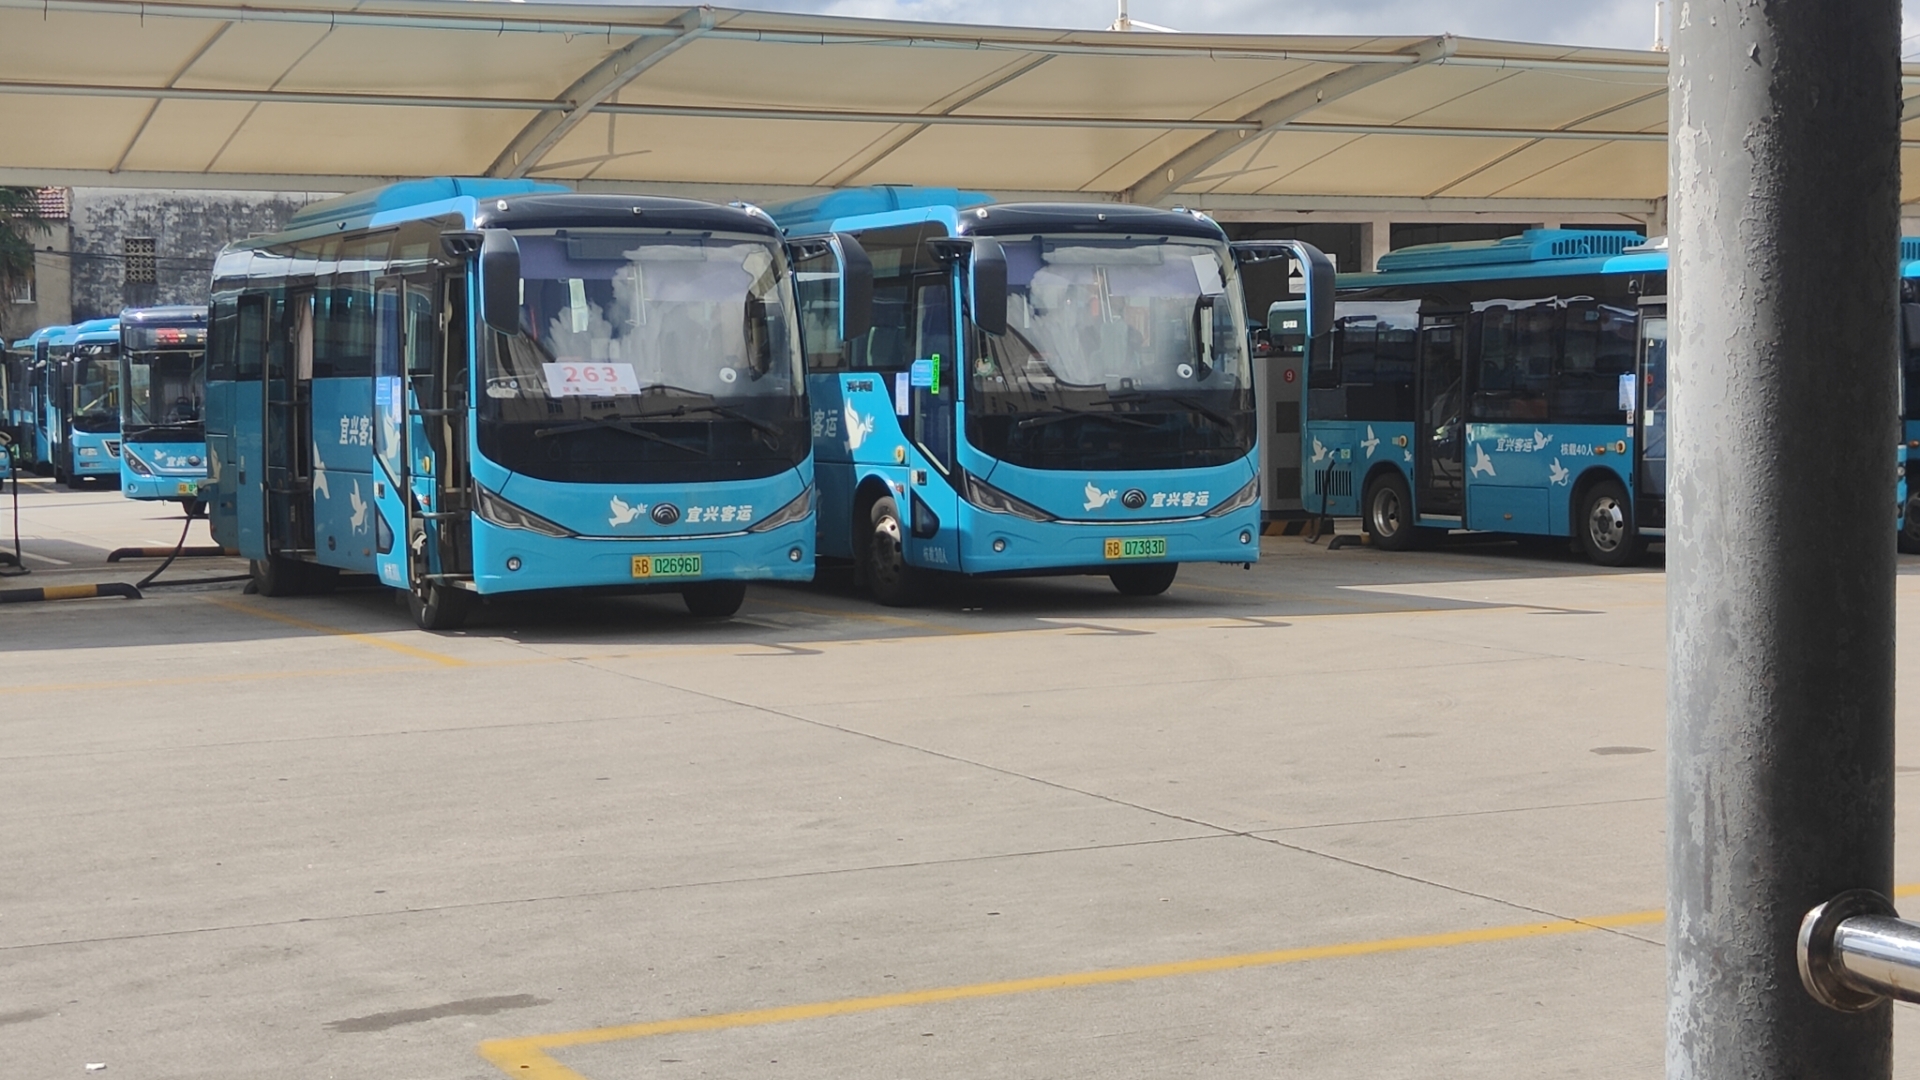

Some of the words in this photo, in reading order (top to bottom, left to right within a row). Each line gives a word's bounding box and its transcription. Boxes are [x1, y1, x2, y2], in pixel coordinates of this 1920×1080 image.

[563, 366, 618, 383] 263
[1286, 371, 1293, 381] 9
[812, 409, 838, 437] 客运
[1495, 438, 1534, 453] 宜兴客运
[1560, 443, 1594, 456] 核载40人
[1150, 491, 1210, 507] 宜兴客运
[685, 505, 753, 523] 宜兴客运
